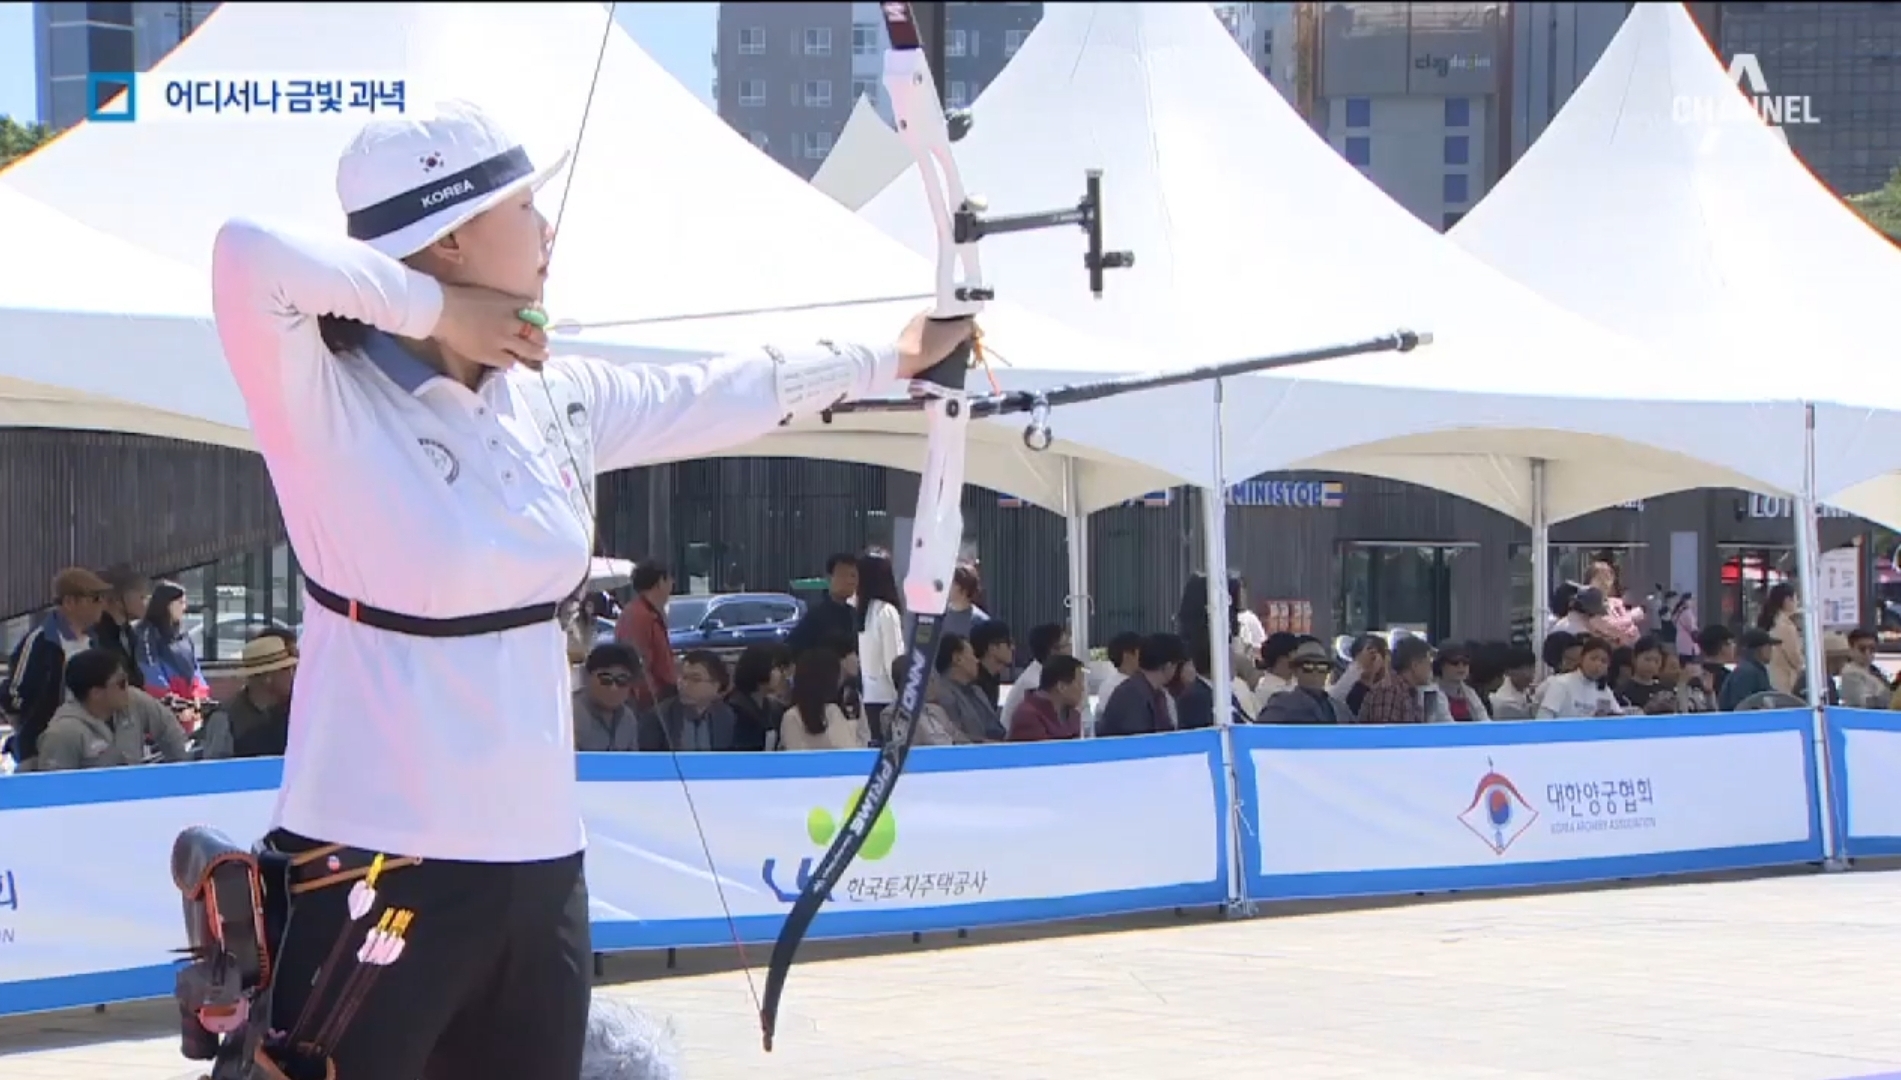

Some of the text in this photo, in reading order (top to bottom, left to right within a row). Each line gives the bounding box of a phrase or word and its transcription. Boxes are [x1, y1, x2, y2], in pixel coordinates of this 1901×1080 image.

[421, 179, 474, 208] KOREA
[850, 760, 893, 837] PRIME
[1546, 778, 1653, 817] 대한양궁협회
[847, 870, 988, 902] 한국토지주택공사
